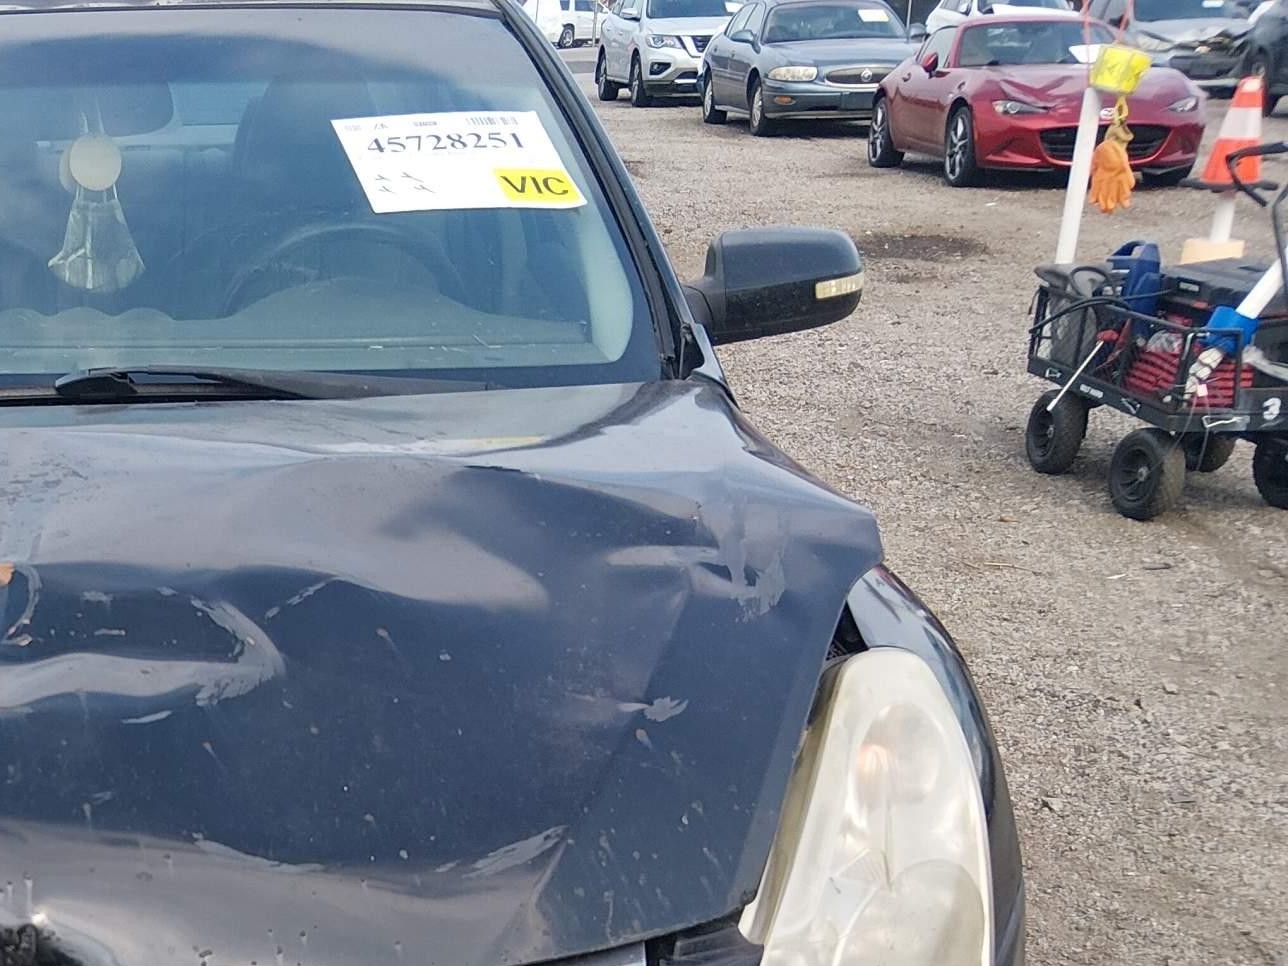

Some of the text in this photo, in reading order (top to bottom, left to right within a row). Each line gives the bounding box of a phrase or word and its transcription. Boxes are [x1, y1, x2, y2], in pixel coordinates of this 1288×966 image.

[368, 132, 525, 153] 45728251
[500, 175, 569, 195] VIC
[1263, 397, 1282, 420] 3
